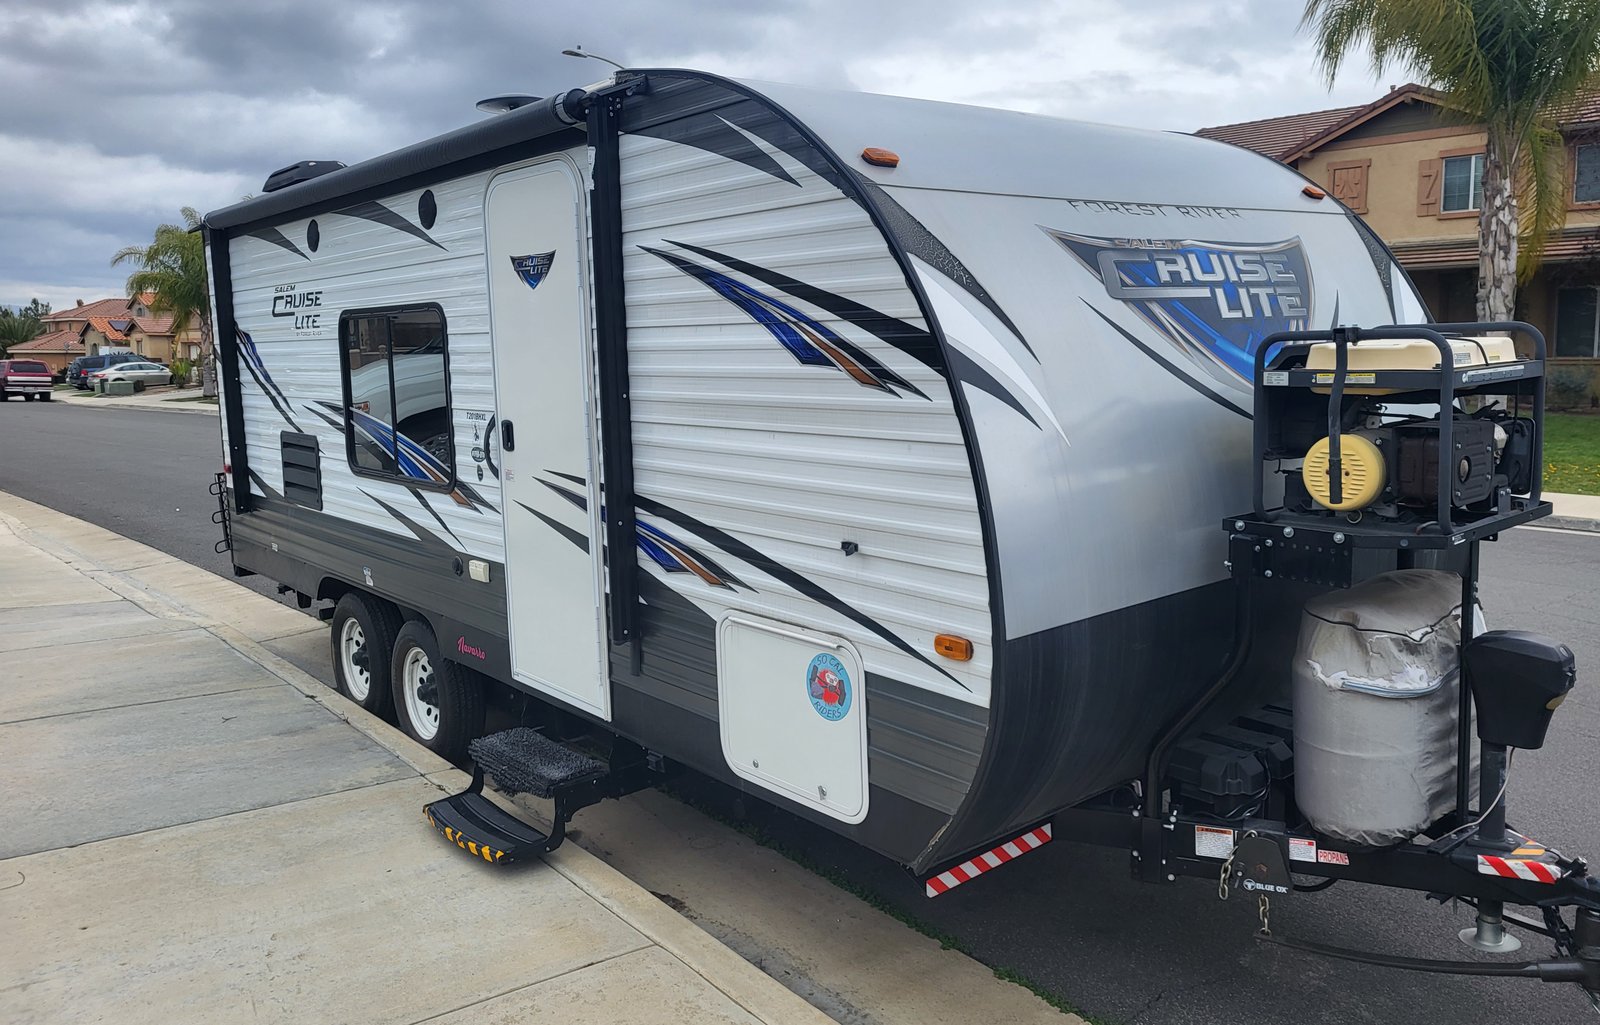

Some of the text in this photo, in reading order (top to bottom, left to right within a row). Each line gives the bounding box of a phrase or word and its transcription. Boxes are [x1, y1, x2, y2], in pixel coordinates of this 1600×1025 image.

[1067, 200, 1245, 220] FOREST RIVER
[1113, 238, 1183, 250] SALEM
[514, 256, 550, 271] CRUISE
[530, 265, 549, 275] LITE
[1096, 250, 1300, 300] CRUISE
[274, 284, 296, 294] SALEM
[272, 291, 323, 318] CRUISE
[1214, 285, 1308, 320] LITE
[295, 314, 321, 330] LITE
[457, 636, 486, 660] Navarro
[816, 655, 845, 676] SO CAL
[814, 700, 842, 719] RIDERS
[1318, 851, 1348, 865] PROPANE
[1255, 882, 1288, 894] BLUE OX
